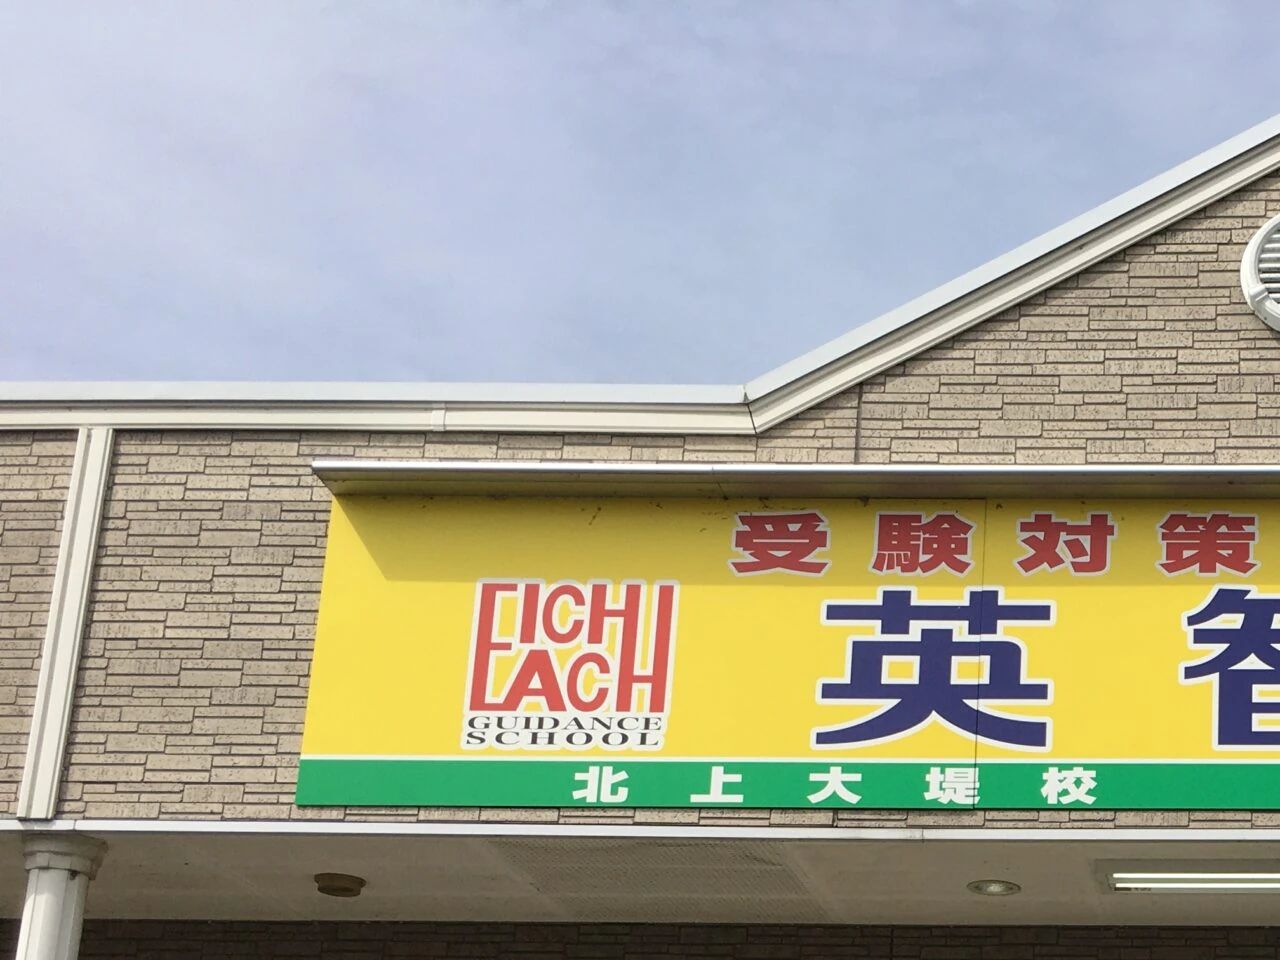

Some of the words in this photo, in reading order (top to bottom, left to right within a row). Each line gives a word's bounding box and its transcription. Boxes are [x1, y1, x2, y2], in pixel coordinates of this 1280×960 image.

[467, 715, 663, 731] GUIDANCE
[465, 731, 660, 746] SCHOOL
[572, 764, 1098, 805] 北上大堤校
